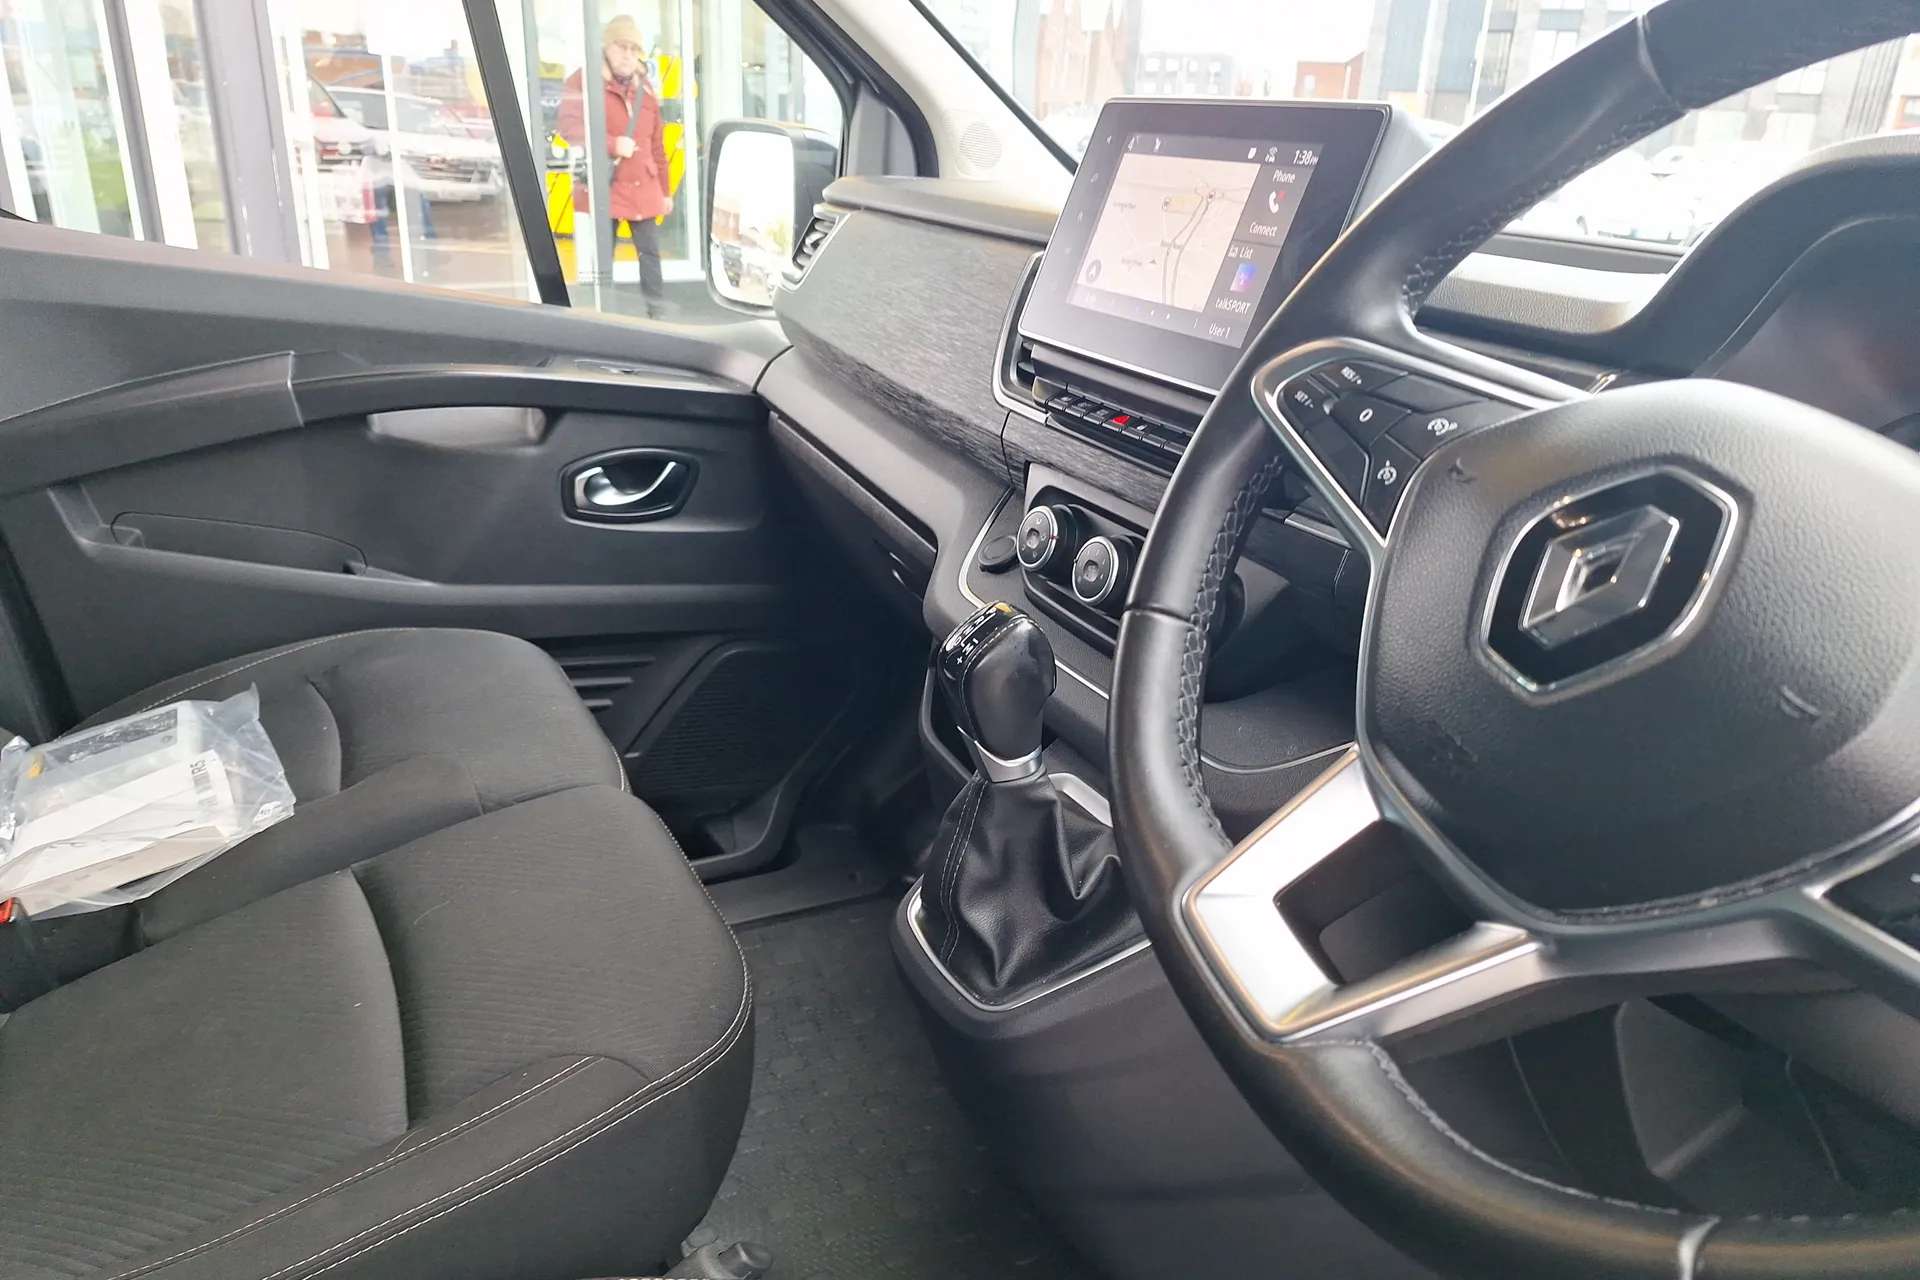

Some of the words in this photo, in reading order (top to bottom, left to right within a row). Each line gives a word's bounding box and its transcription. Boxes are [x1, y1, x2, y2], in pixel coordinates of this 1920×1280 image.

[1272, 169, 1296, 184] Phone
[1250, 221, 1278, 238] Connect
[1239, 247, 1253, 260] List
[1208, 323, 1225, 338] User
